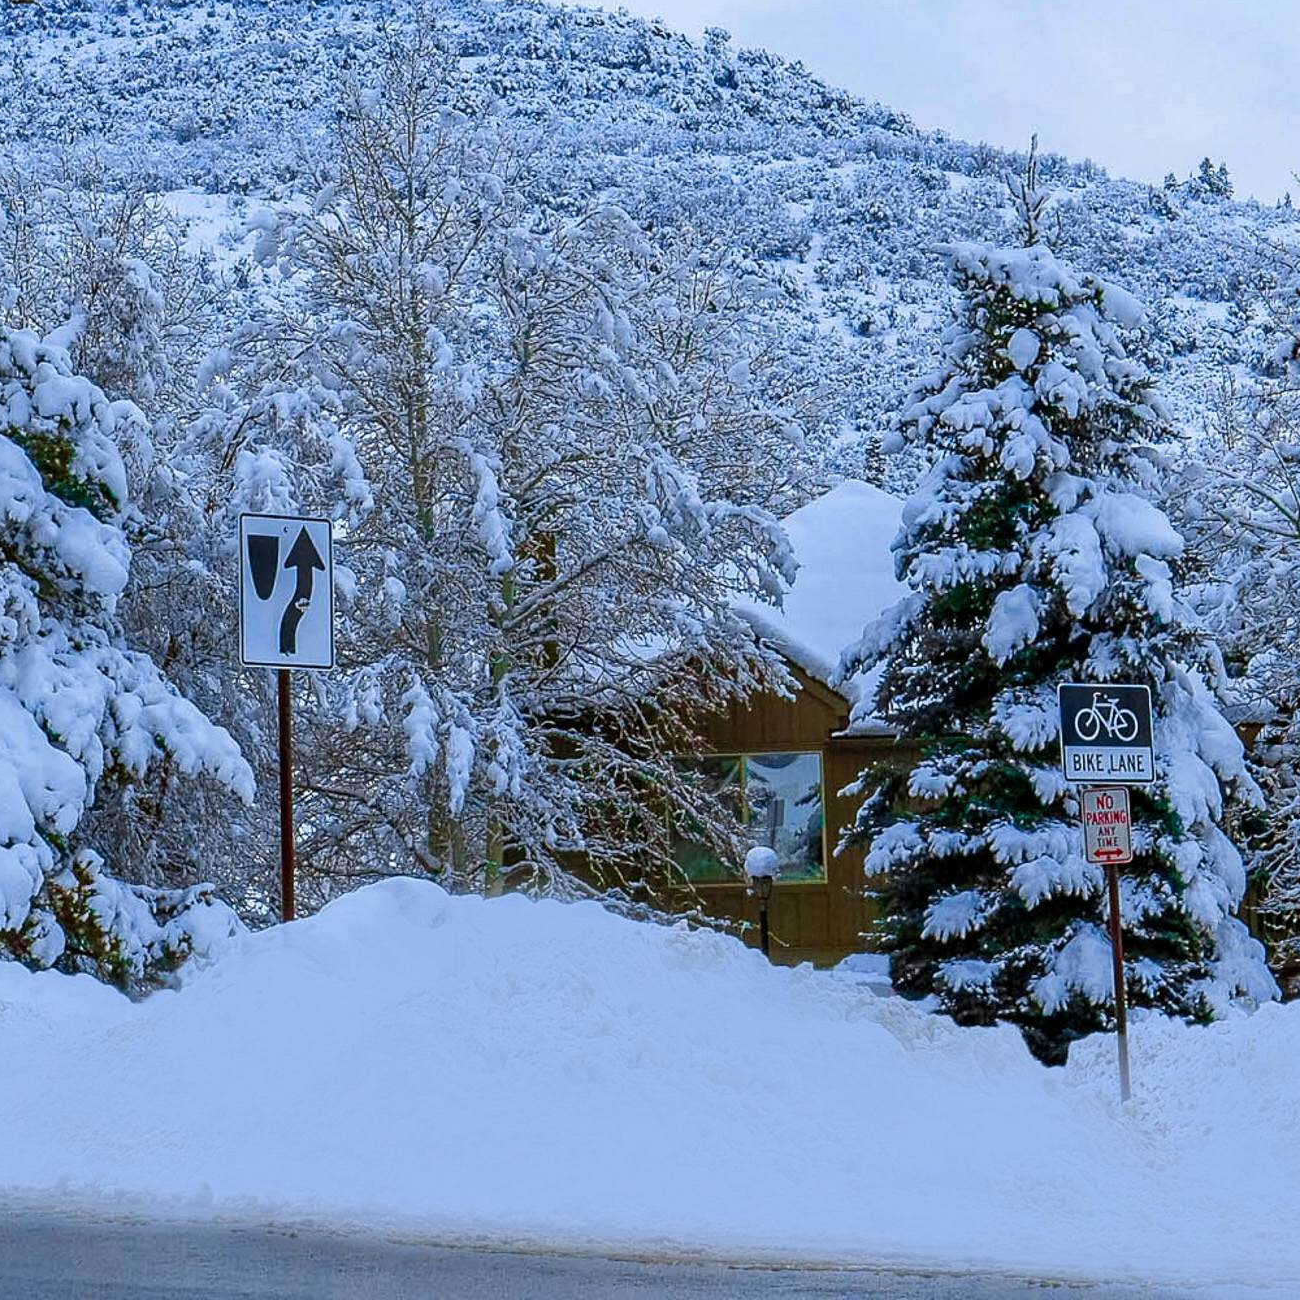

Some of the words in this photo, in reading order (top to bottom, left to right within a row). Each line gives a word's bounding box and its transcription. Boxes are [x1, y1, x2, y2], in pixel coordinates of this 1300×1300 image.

[1073, 754, 1103, 772] BIKE
[1110, 754, 1145, 772] LANE
[1096, 795, 1114, 810] NO
[1087, 810, 1127, 826] PARKING
[1098, 826, 1116, 837] ANY
[1097, 837, 1119, 847] TIME
